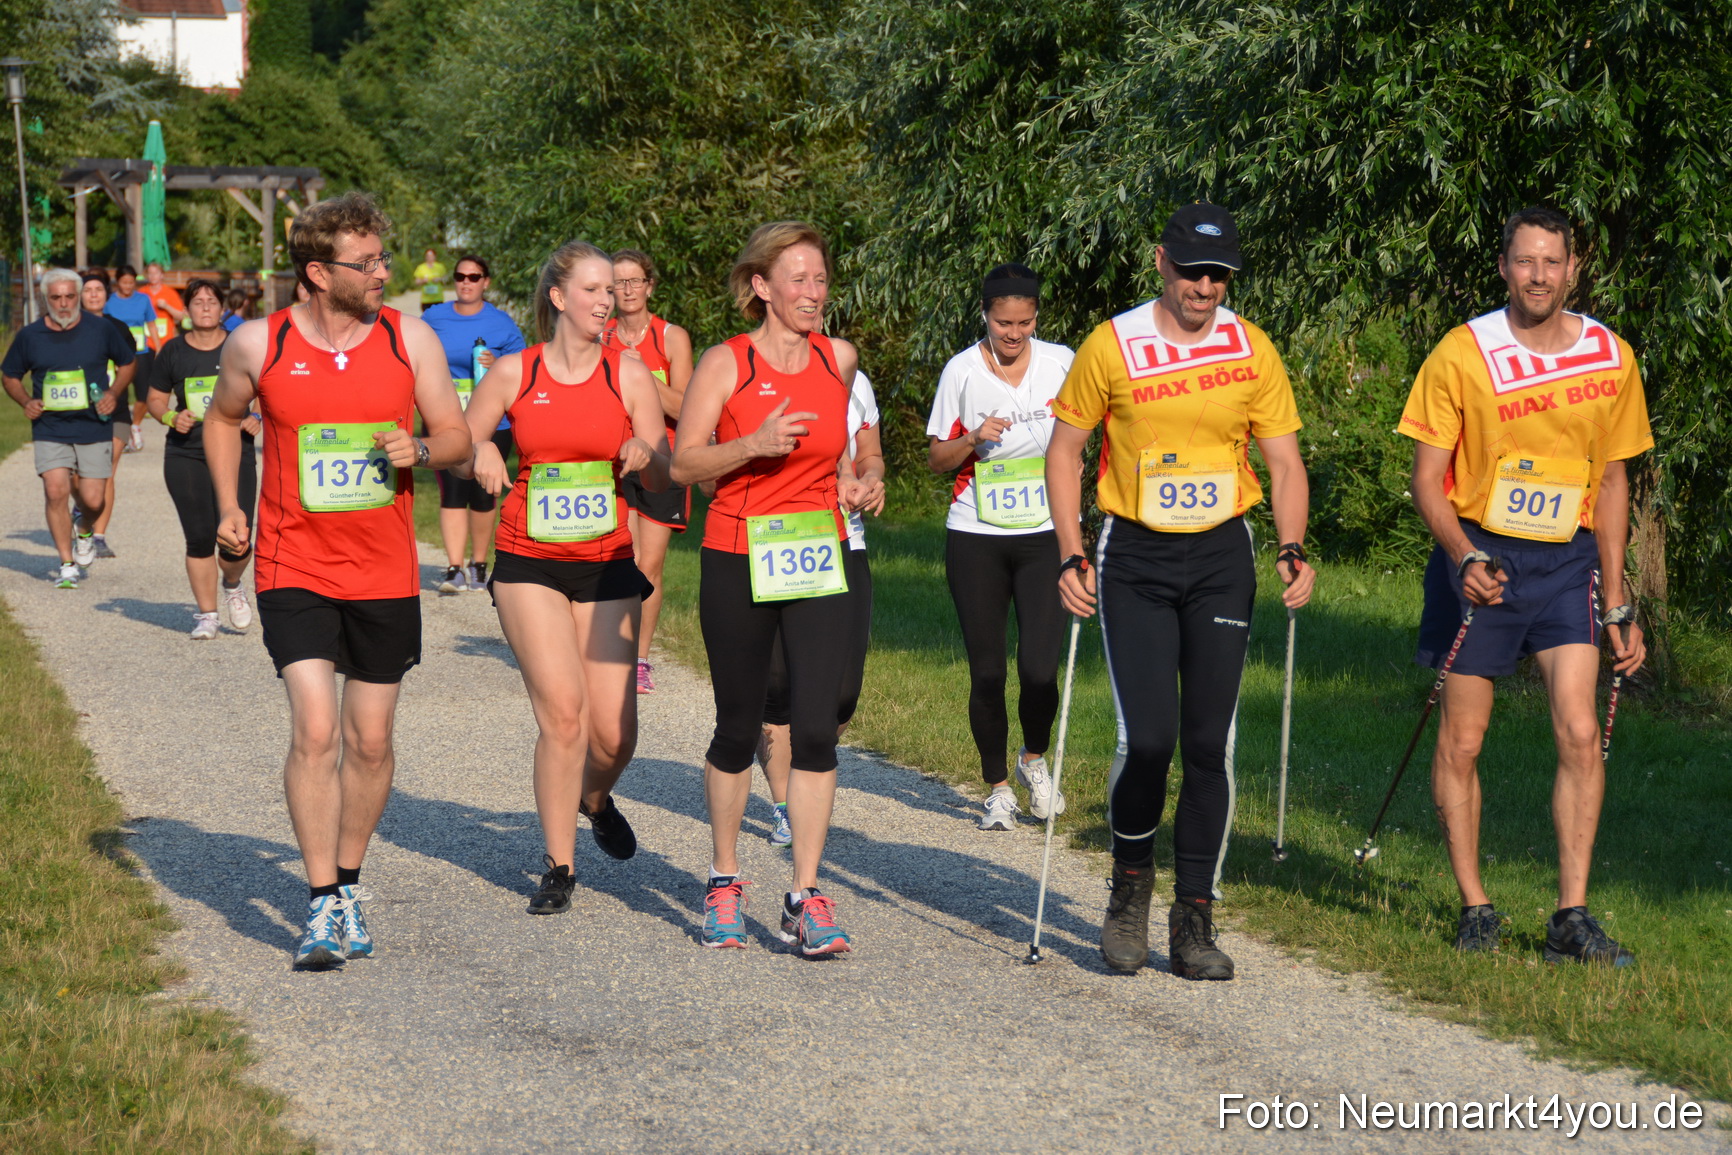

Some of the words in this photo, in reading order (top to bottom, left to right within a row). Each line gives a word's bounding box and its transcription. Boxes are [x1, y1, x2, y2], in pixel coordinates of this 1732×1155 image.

[51, 386, 78, 400] 846
[1132, 378, 1191, 405] MAX
[1197, 366, 1259, 391] BÖGL
[1497, 392, 1559, 423] MAX
[314, 437, 350, 445] firmenlauf
[310, 457, 389, 487] 1373
[1155, 461, 1190, 469] firmenlauf
[1510, 467, 1545, 478] firmenlauf
[329, 491, 354, 499] Günther
[355, 490, 371, 498] Frank
[537, 493, 608, 520] 1363
[986, 484, 1046, 511] 1511
[1159, 481, 1218, 509] 933
[1507, 487, 1563, 519] 901
[1505, 518, 1524, 526] Martin
[761, 544, 834, 577] 1362
